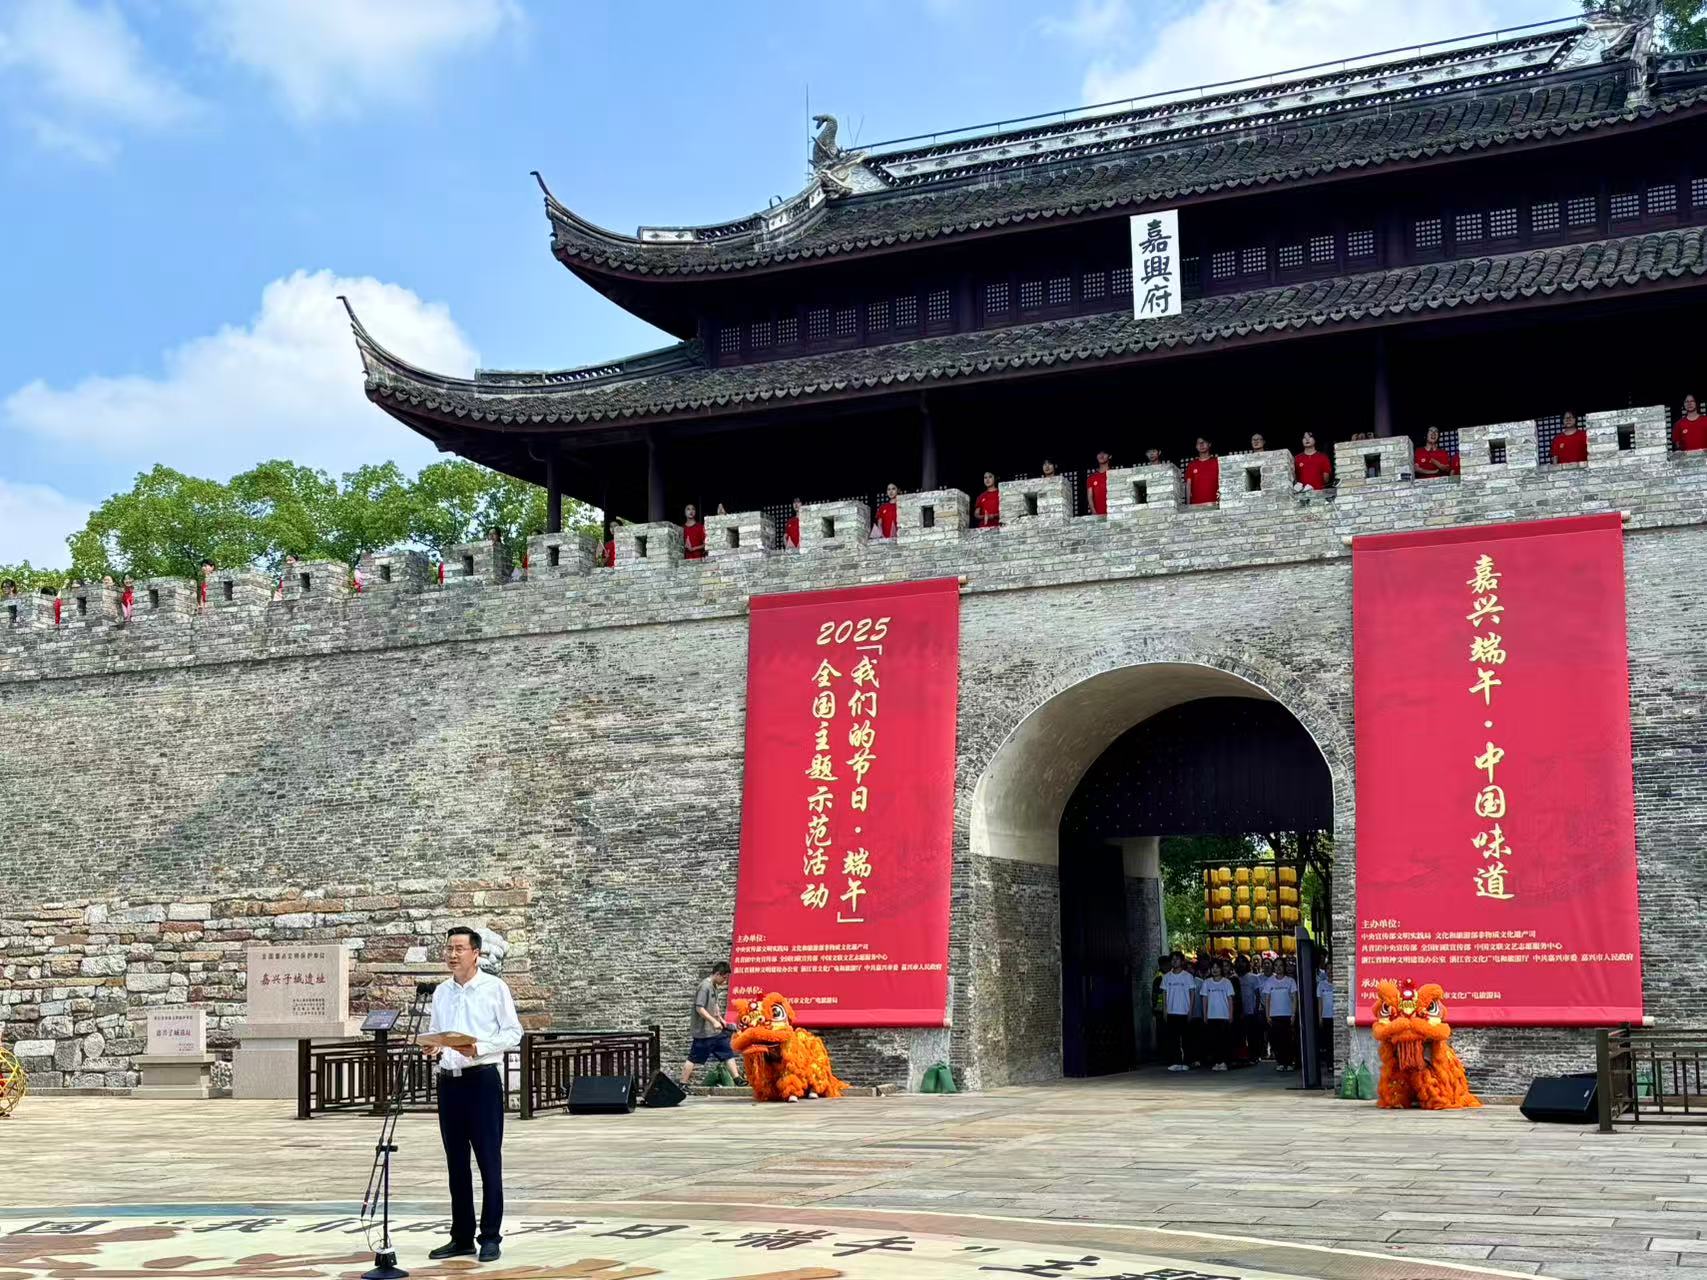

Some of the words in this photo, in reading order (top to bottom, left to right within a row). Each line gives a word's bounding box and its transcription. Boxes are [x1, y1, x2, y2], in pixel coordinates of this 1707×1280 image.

[1139, 219, 1172, 314] 嘉興府
[816, 616, 891, 646] 2025
[1465, 553, 1515, 901] 嘉兴端午·中国味道
[800, 658, 842, 911] 全国主题示范活动
[260, 973, 327, 987] 嘉兴子城遗址
